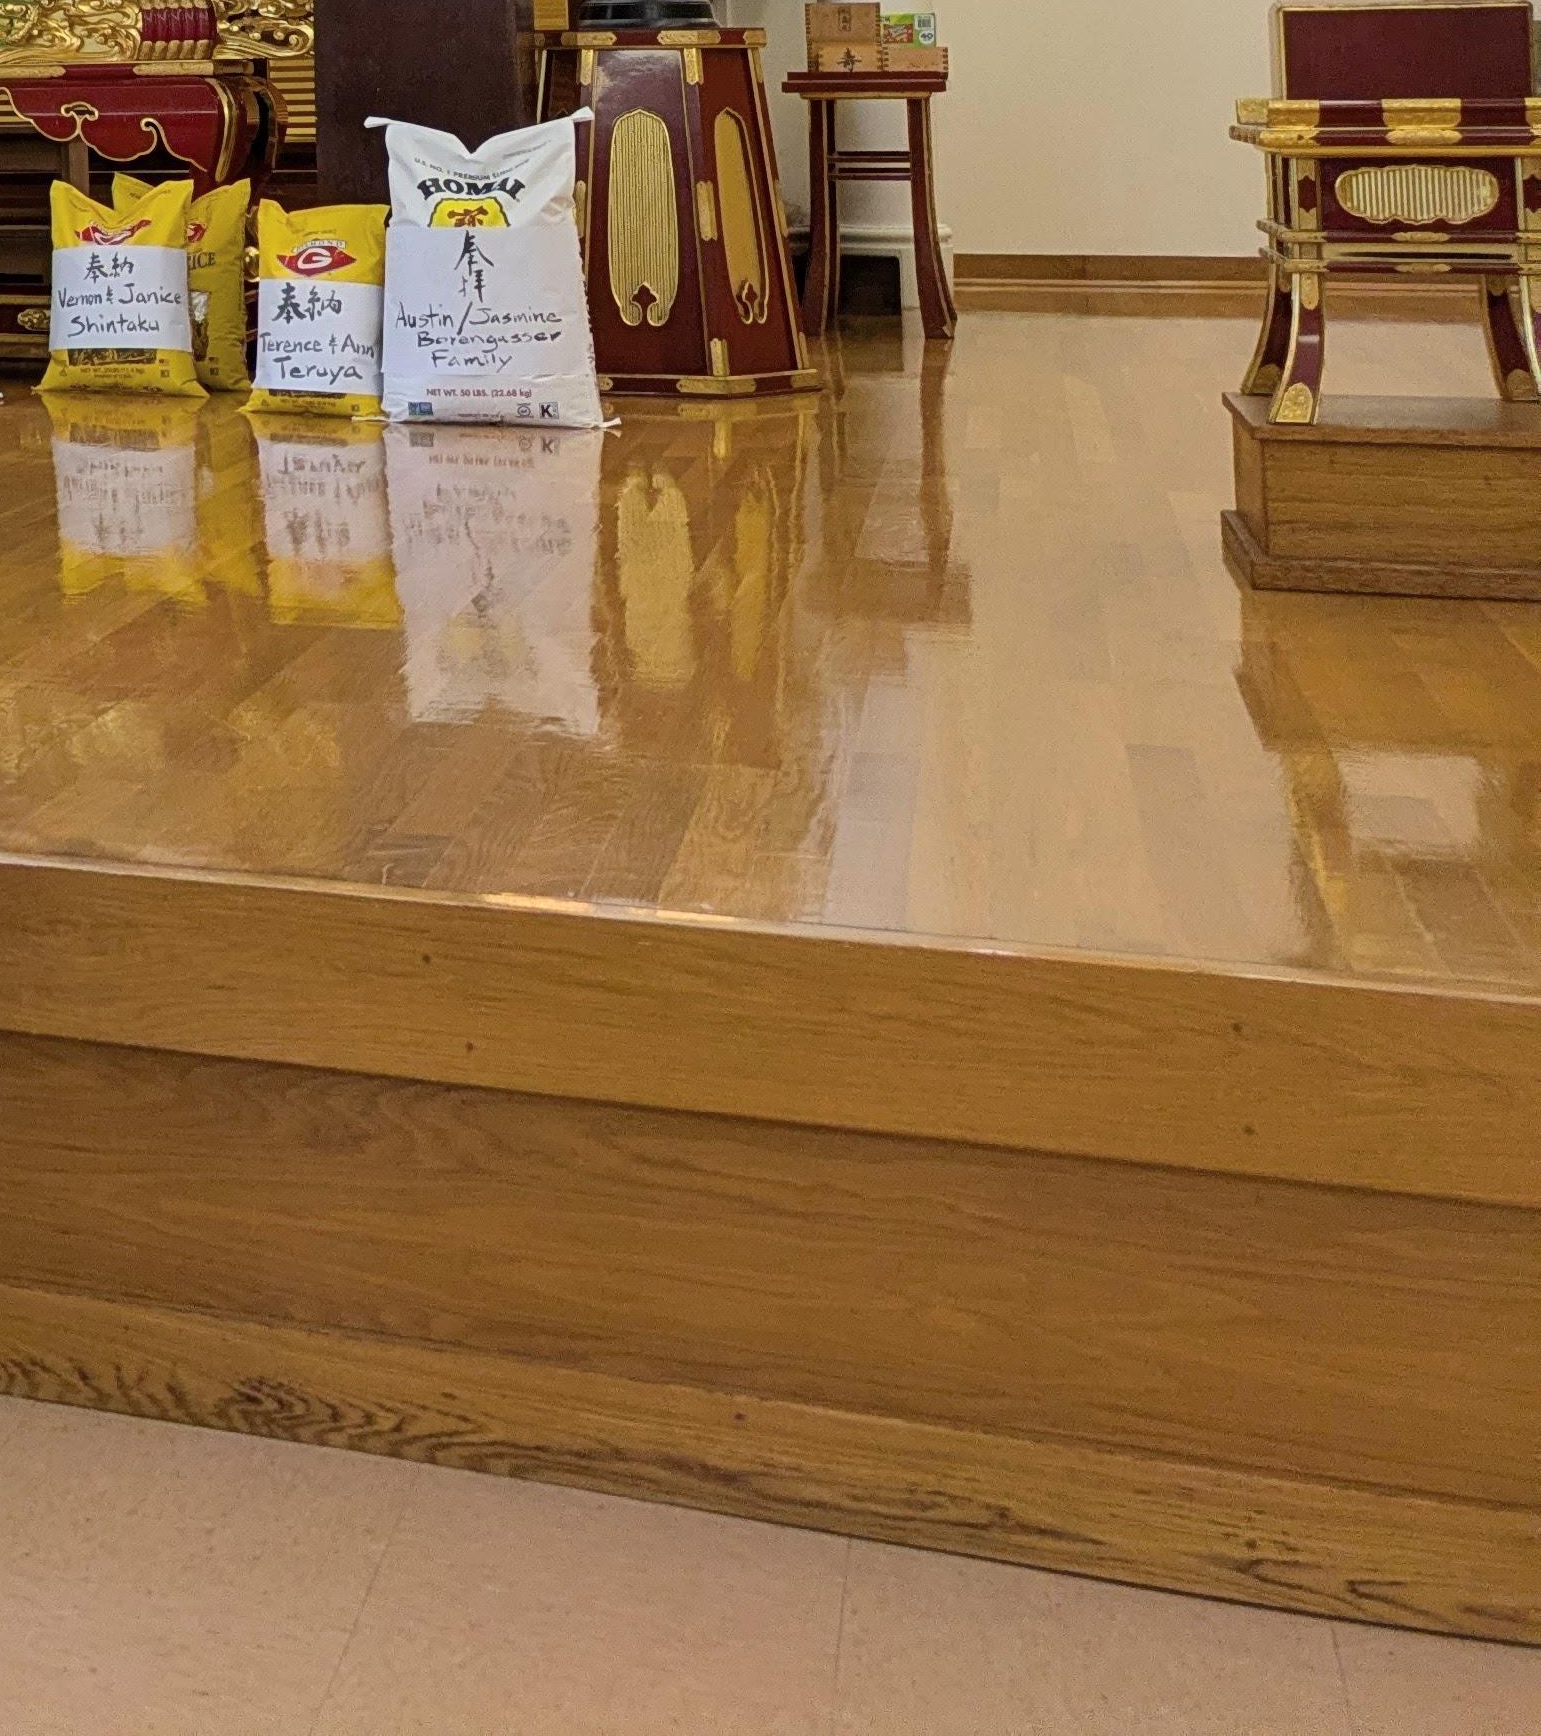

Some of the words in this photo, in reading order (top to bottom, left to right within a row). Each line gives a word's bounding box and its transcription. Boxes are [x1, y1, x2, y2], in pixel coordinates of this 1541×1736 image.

[83, 252, 135, 283] 奉納
[118, 283, 182, 305] Janice
[272, 282, 343, 324] 奉納
[68, 314, 160, 338] Shintaku
[260, 332, 323, 354] Terence
[341, 334, 375, 359] Ann
[273, 356, 363, 386] Teruya
[431, 349, 513, 374] Family
[426, 388, 441, 397] NET
[460, 388, 471, 397] 50
